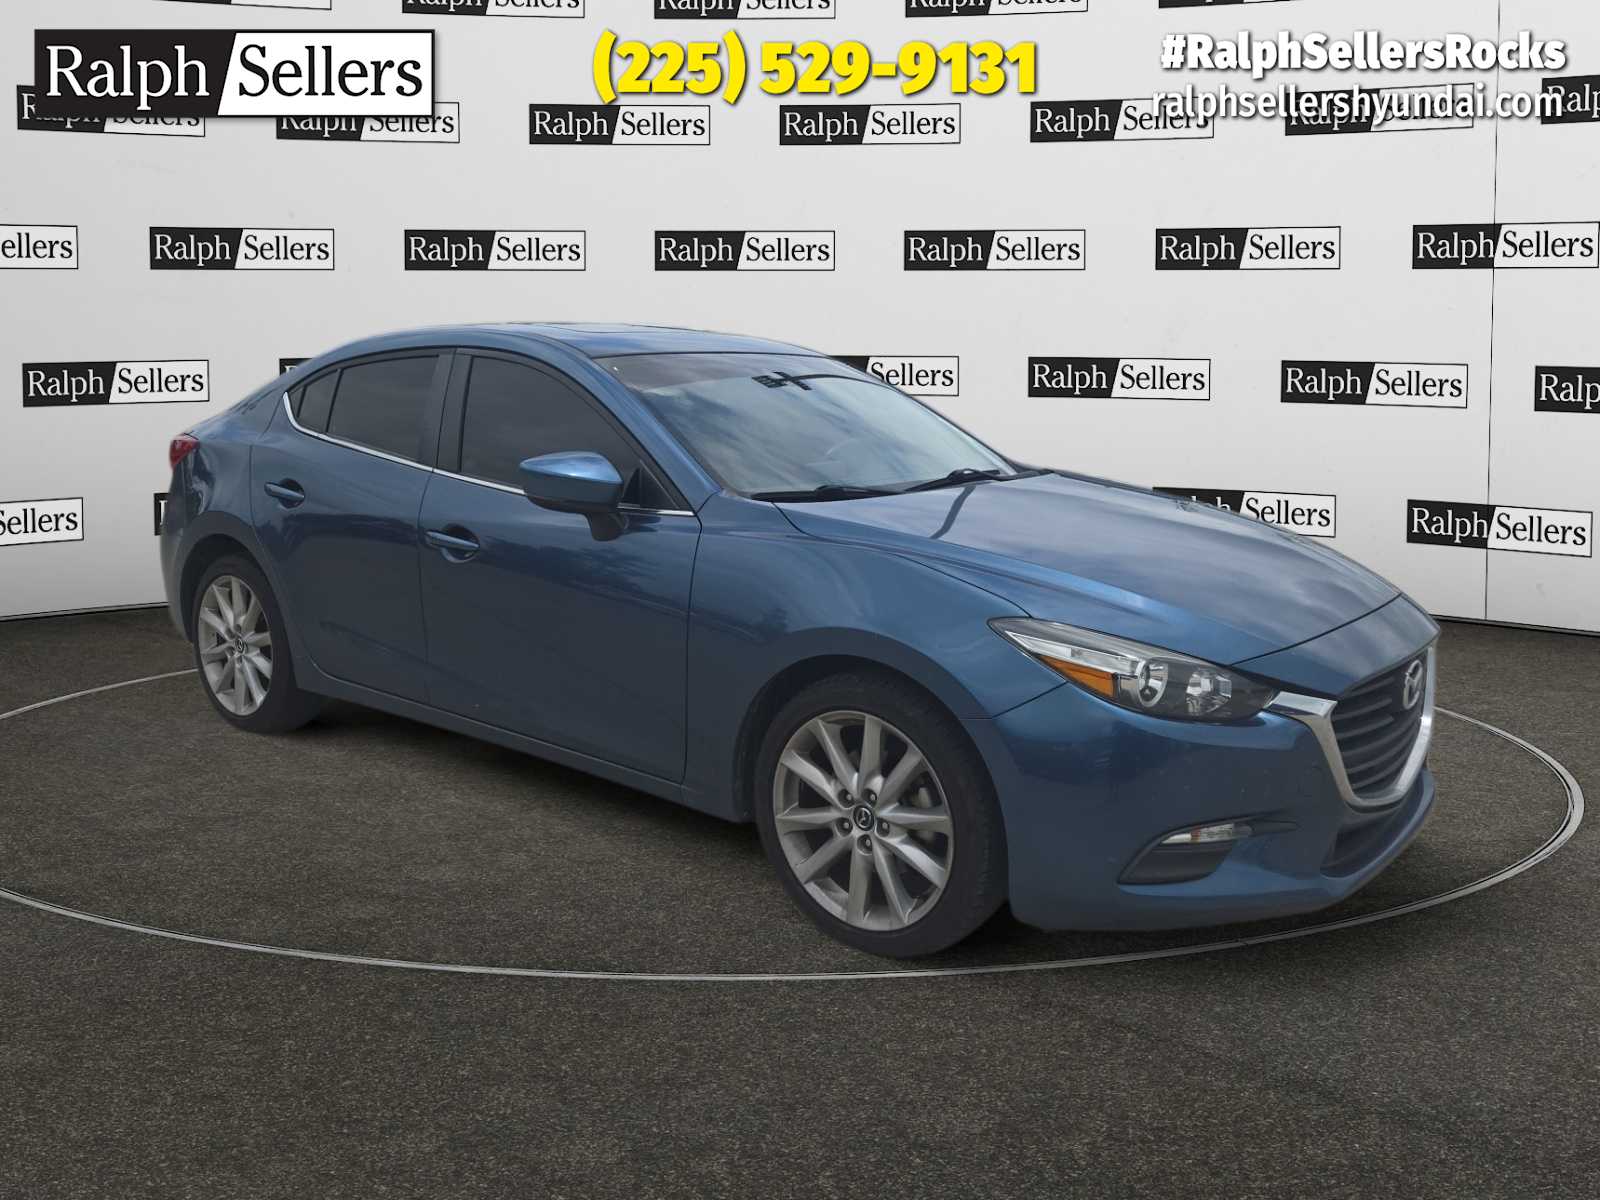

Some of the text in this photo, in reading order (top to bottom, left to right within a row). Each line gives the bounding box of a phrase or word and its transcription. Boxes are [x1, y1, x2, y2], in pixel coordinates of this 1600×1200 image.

[533, 111, 705, 141] Ralph Sellers
[784, 111, 955, 142] Ralph Sellers
[1035, 106, 1110, 138] Ralph
[1, 232, 73, 259] ellers
[154, 234, 329, 266] Ralph Sellers
[409, 237, 581, 267] Ralph Sellers
[659, 237, 830, 267] Ralph Sellers
[908, 237, 1081, 267] Ralph Sellers
[1160, 233, 1335, 266] Ralph Sellers
[1417, 230, 1593, 265] Ralph Sellers
[27, 367, 204, 401] Ralph Sellers
[1032, 364, 1205, 394] Ralph Sellers
[1286, 367, 1463, 400] Ralph Sellers
[1411, 507, 1586, 546] Ralph Sellers
